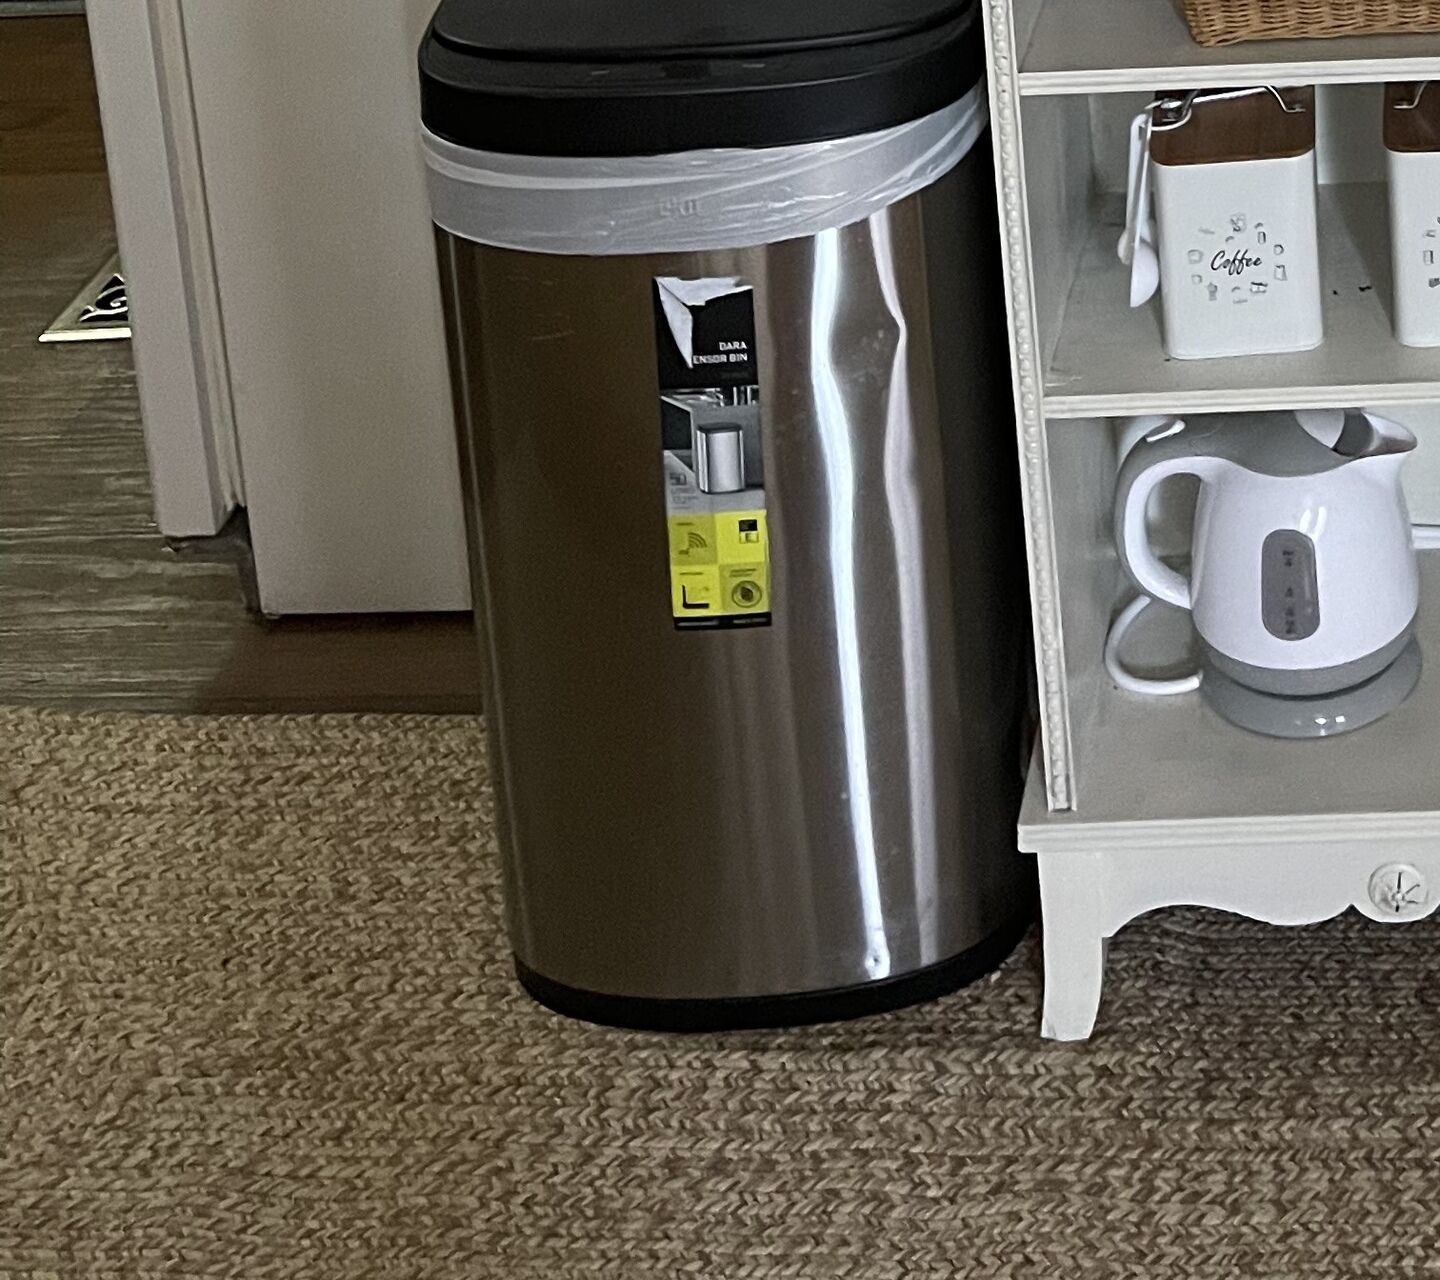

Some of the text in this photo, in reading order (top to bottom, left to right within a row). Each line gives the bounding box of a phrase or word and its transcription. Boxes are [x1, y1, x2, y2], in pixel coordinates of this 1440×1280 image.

[1210, 249, 1263, 275] Coffee
[719, 341, 747, 351] DARA
[693, 353, 748, 364] ENSOR BIN
